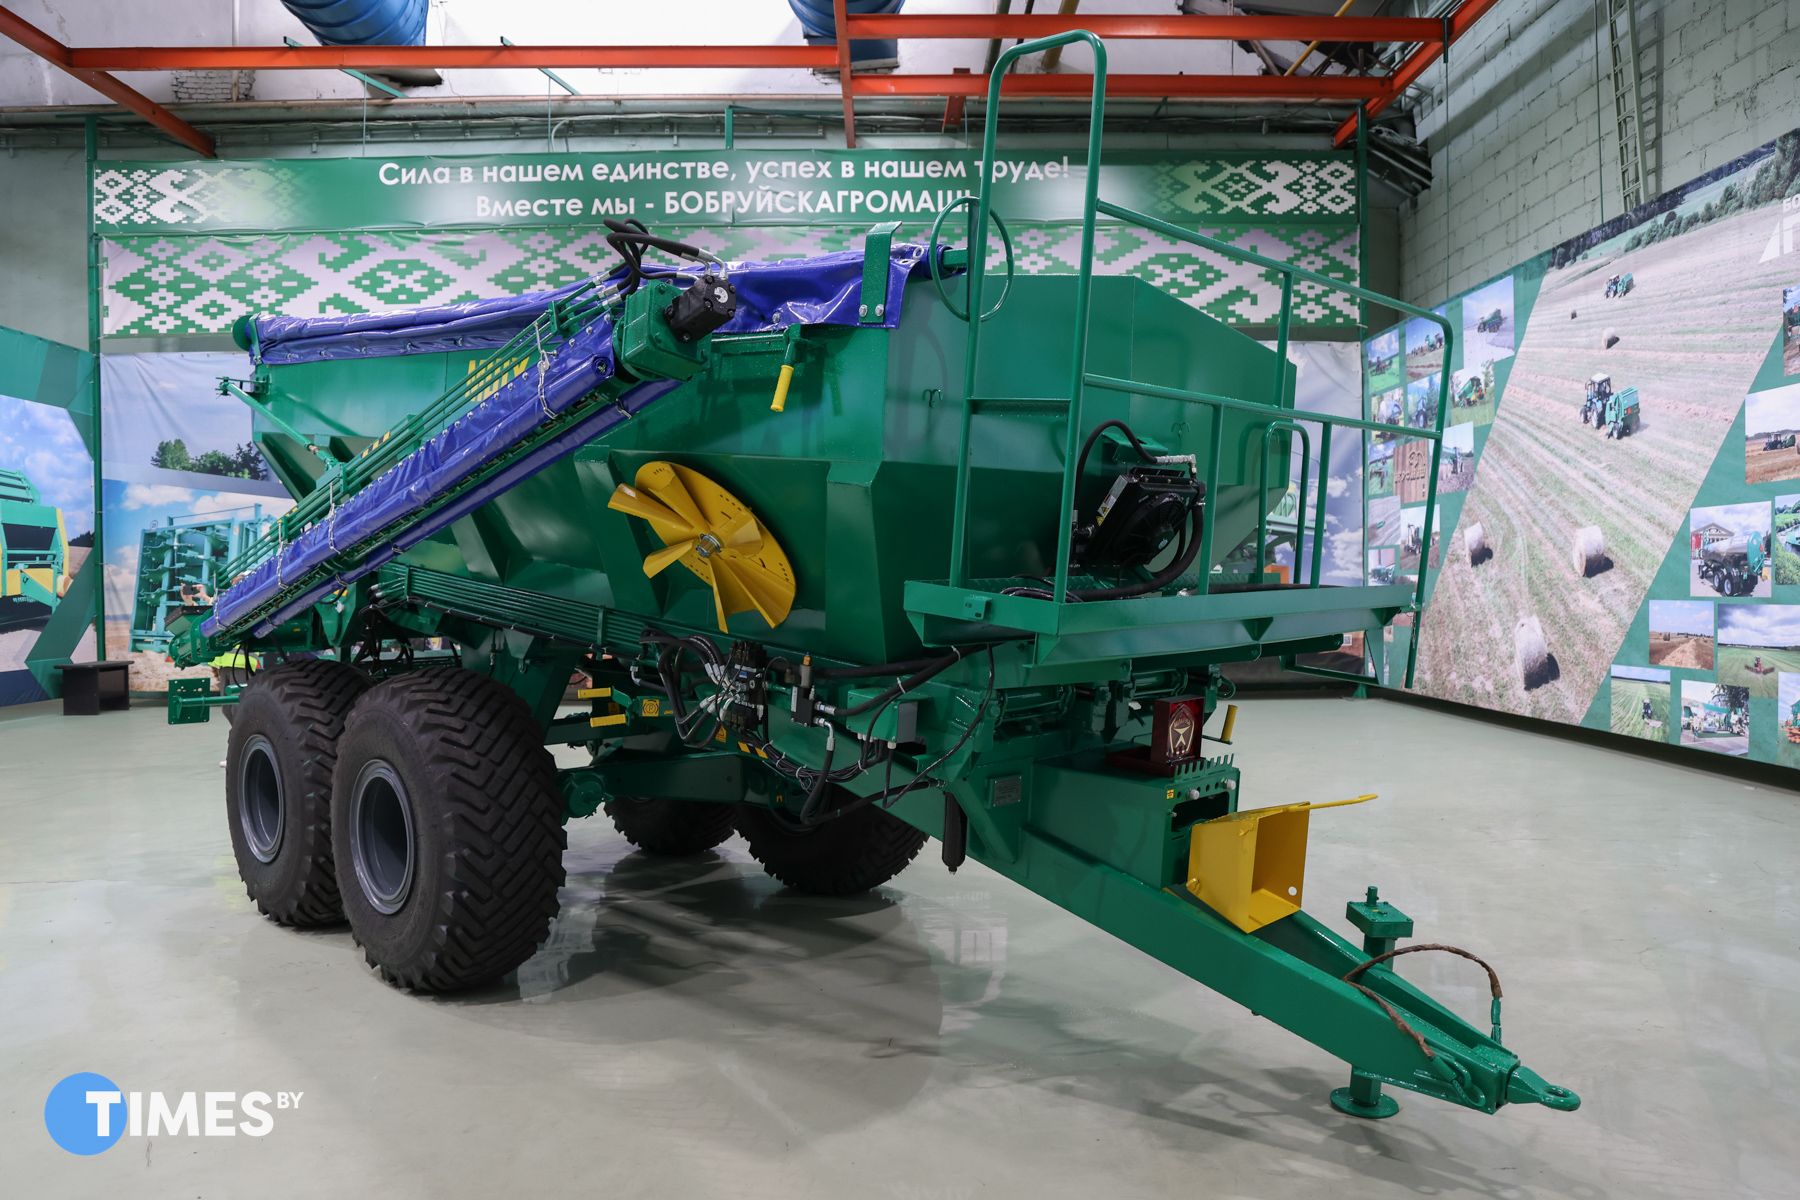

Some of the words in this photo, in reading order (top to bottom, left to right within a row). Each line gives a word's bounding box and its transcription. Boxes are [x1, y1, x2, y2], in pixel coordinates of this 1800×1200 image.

[378, 162, 450, 185] Сила
[460, 166, 473, 183] в
[483, 163, 584, 182] нашем
[591, 160, 736, 183] единстве,
[745, 160, 833, 182] успех
[841, 160, 855, 179] в
[864, 159, 967, 179] нашем
[476, 195, 584, 217] Вместе
[591, 196, 635, 215] мы
